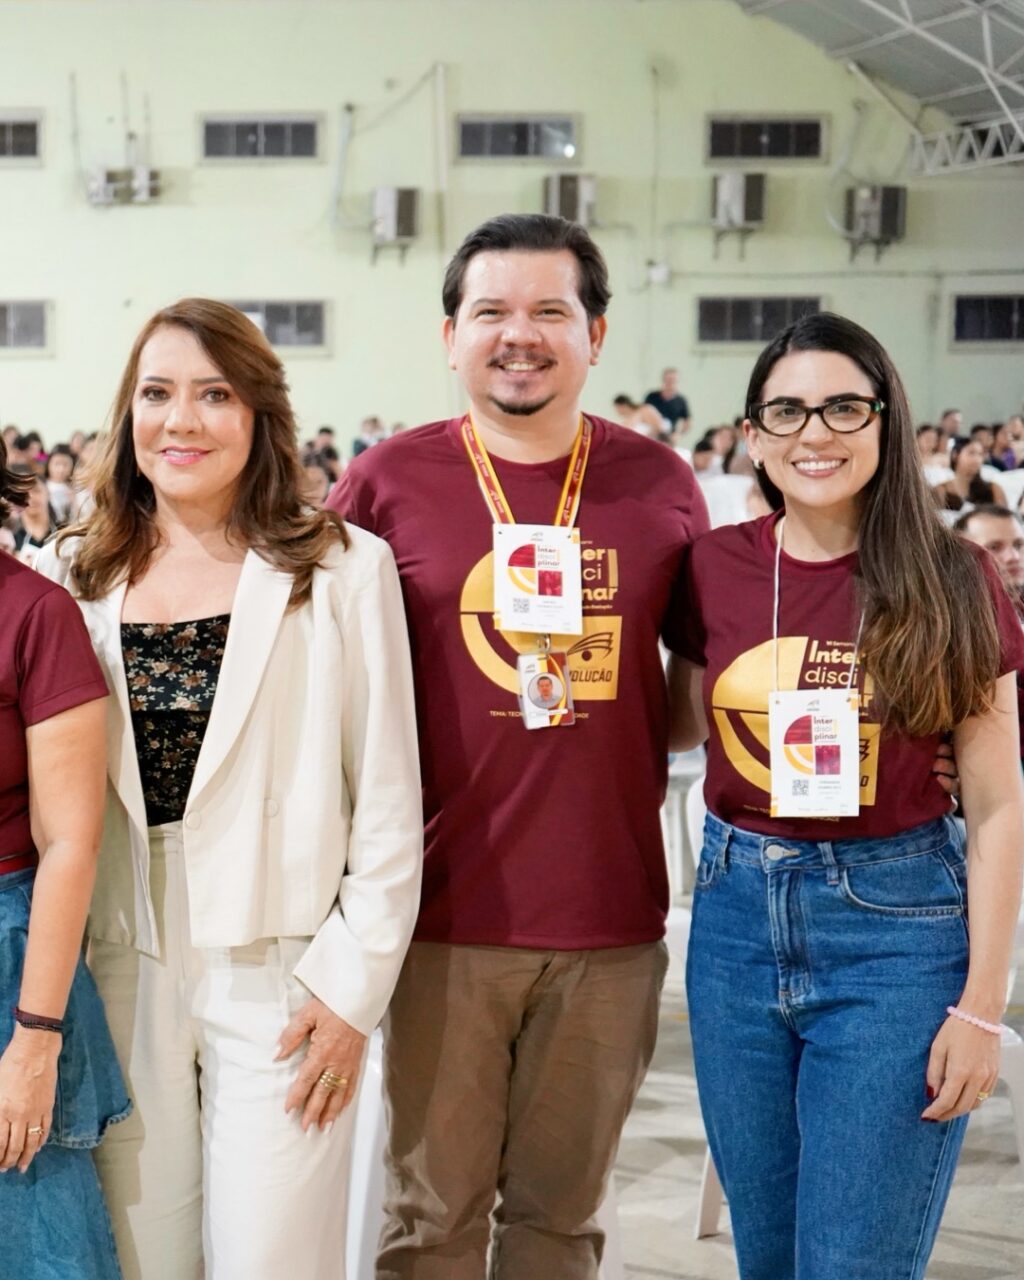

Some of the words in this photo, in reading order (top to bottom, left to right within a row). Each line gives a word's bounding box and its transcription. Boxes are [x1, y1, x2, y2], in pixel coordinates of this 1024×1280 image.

[582, 587, 618, 601] nar
[814, 716, 833, 724] Inter
[815, 733, 837, 741] plinar
